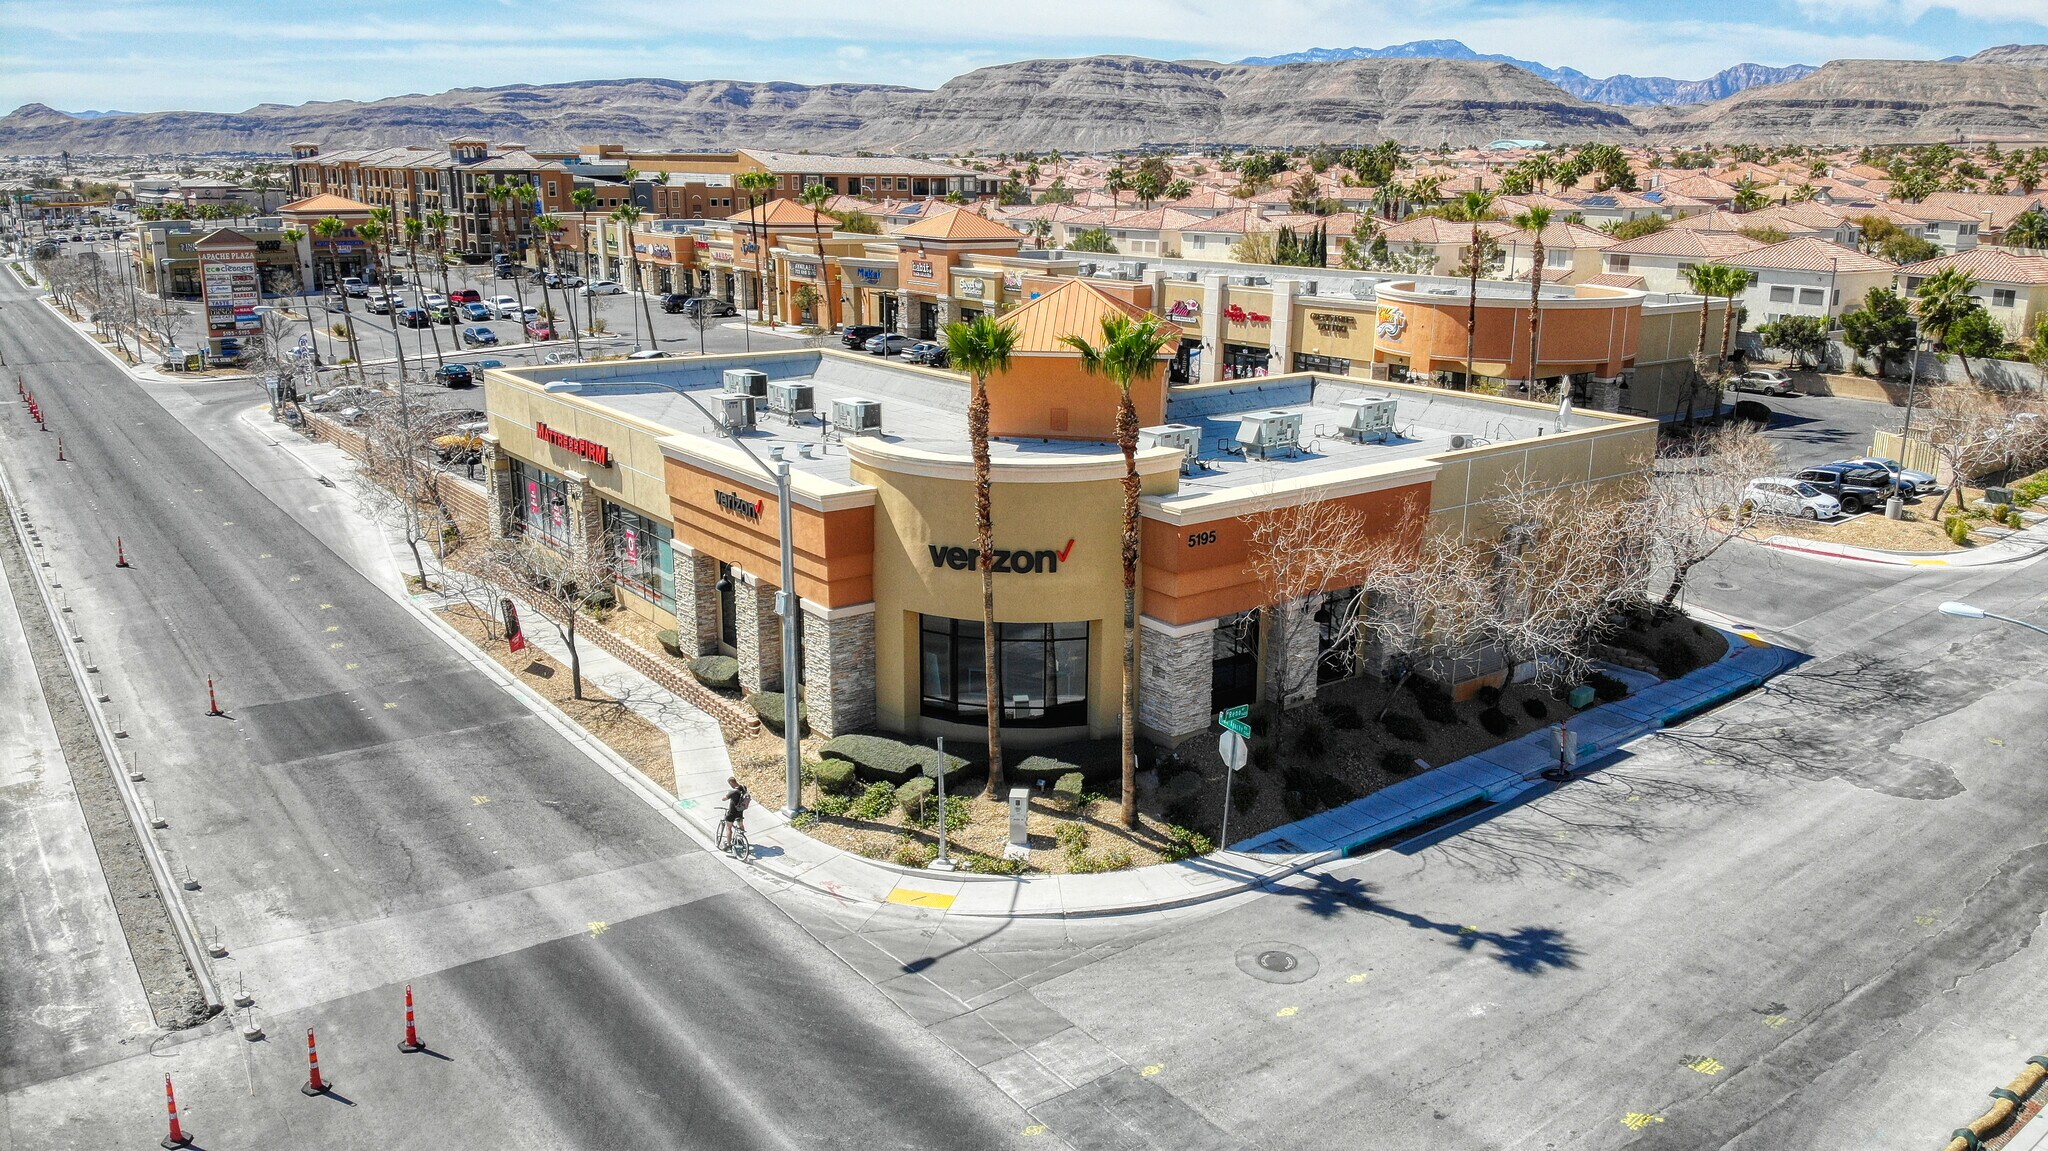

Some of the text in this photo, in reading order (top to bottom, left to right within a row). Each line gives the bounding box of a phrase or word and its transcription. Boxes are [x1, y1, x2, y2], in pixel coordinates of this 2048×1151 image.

[202, 252, 230, 260] APACHE
[714, 489, 757, 519] verizon
[1188, 530, 1217, 548] 5195
[928, 544, 1057, 574] verzon
